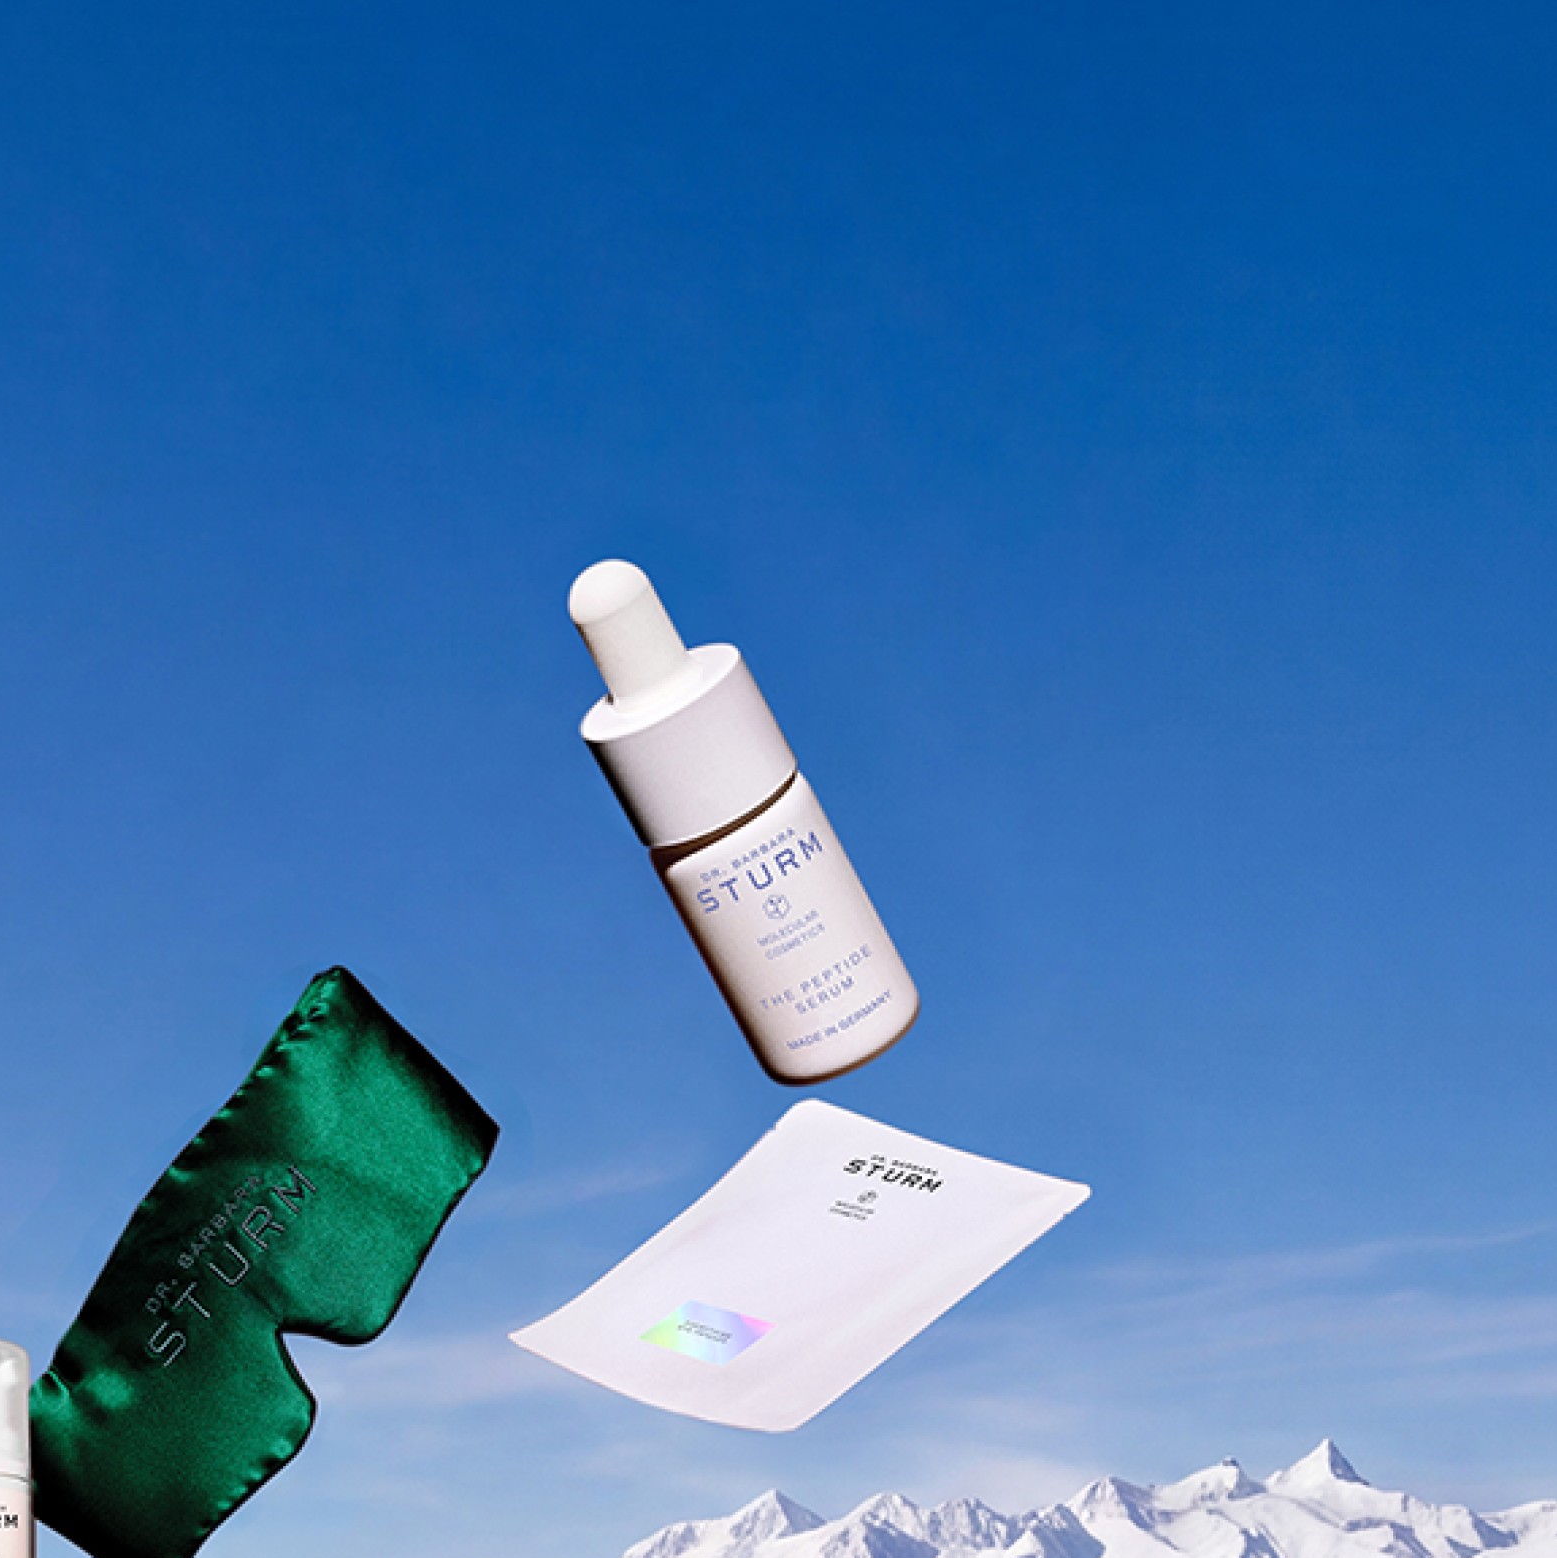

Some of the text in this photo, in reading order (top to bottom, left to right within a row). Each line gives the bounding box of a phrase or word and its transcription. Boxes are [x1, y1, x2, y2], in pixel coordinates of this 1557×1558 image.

[696, 832, 823, 914] STURM
[761, 943, 872, 1009] THE PEPTIDE
[795, 975, 855, 1014] SERUM
[843, 1158, 943, 1193] STURM
[177, 1174, 264, 1270] BARBARA
[147, 1164, 318, 1368] STURM
